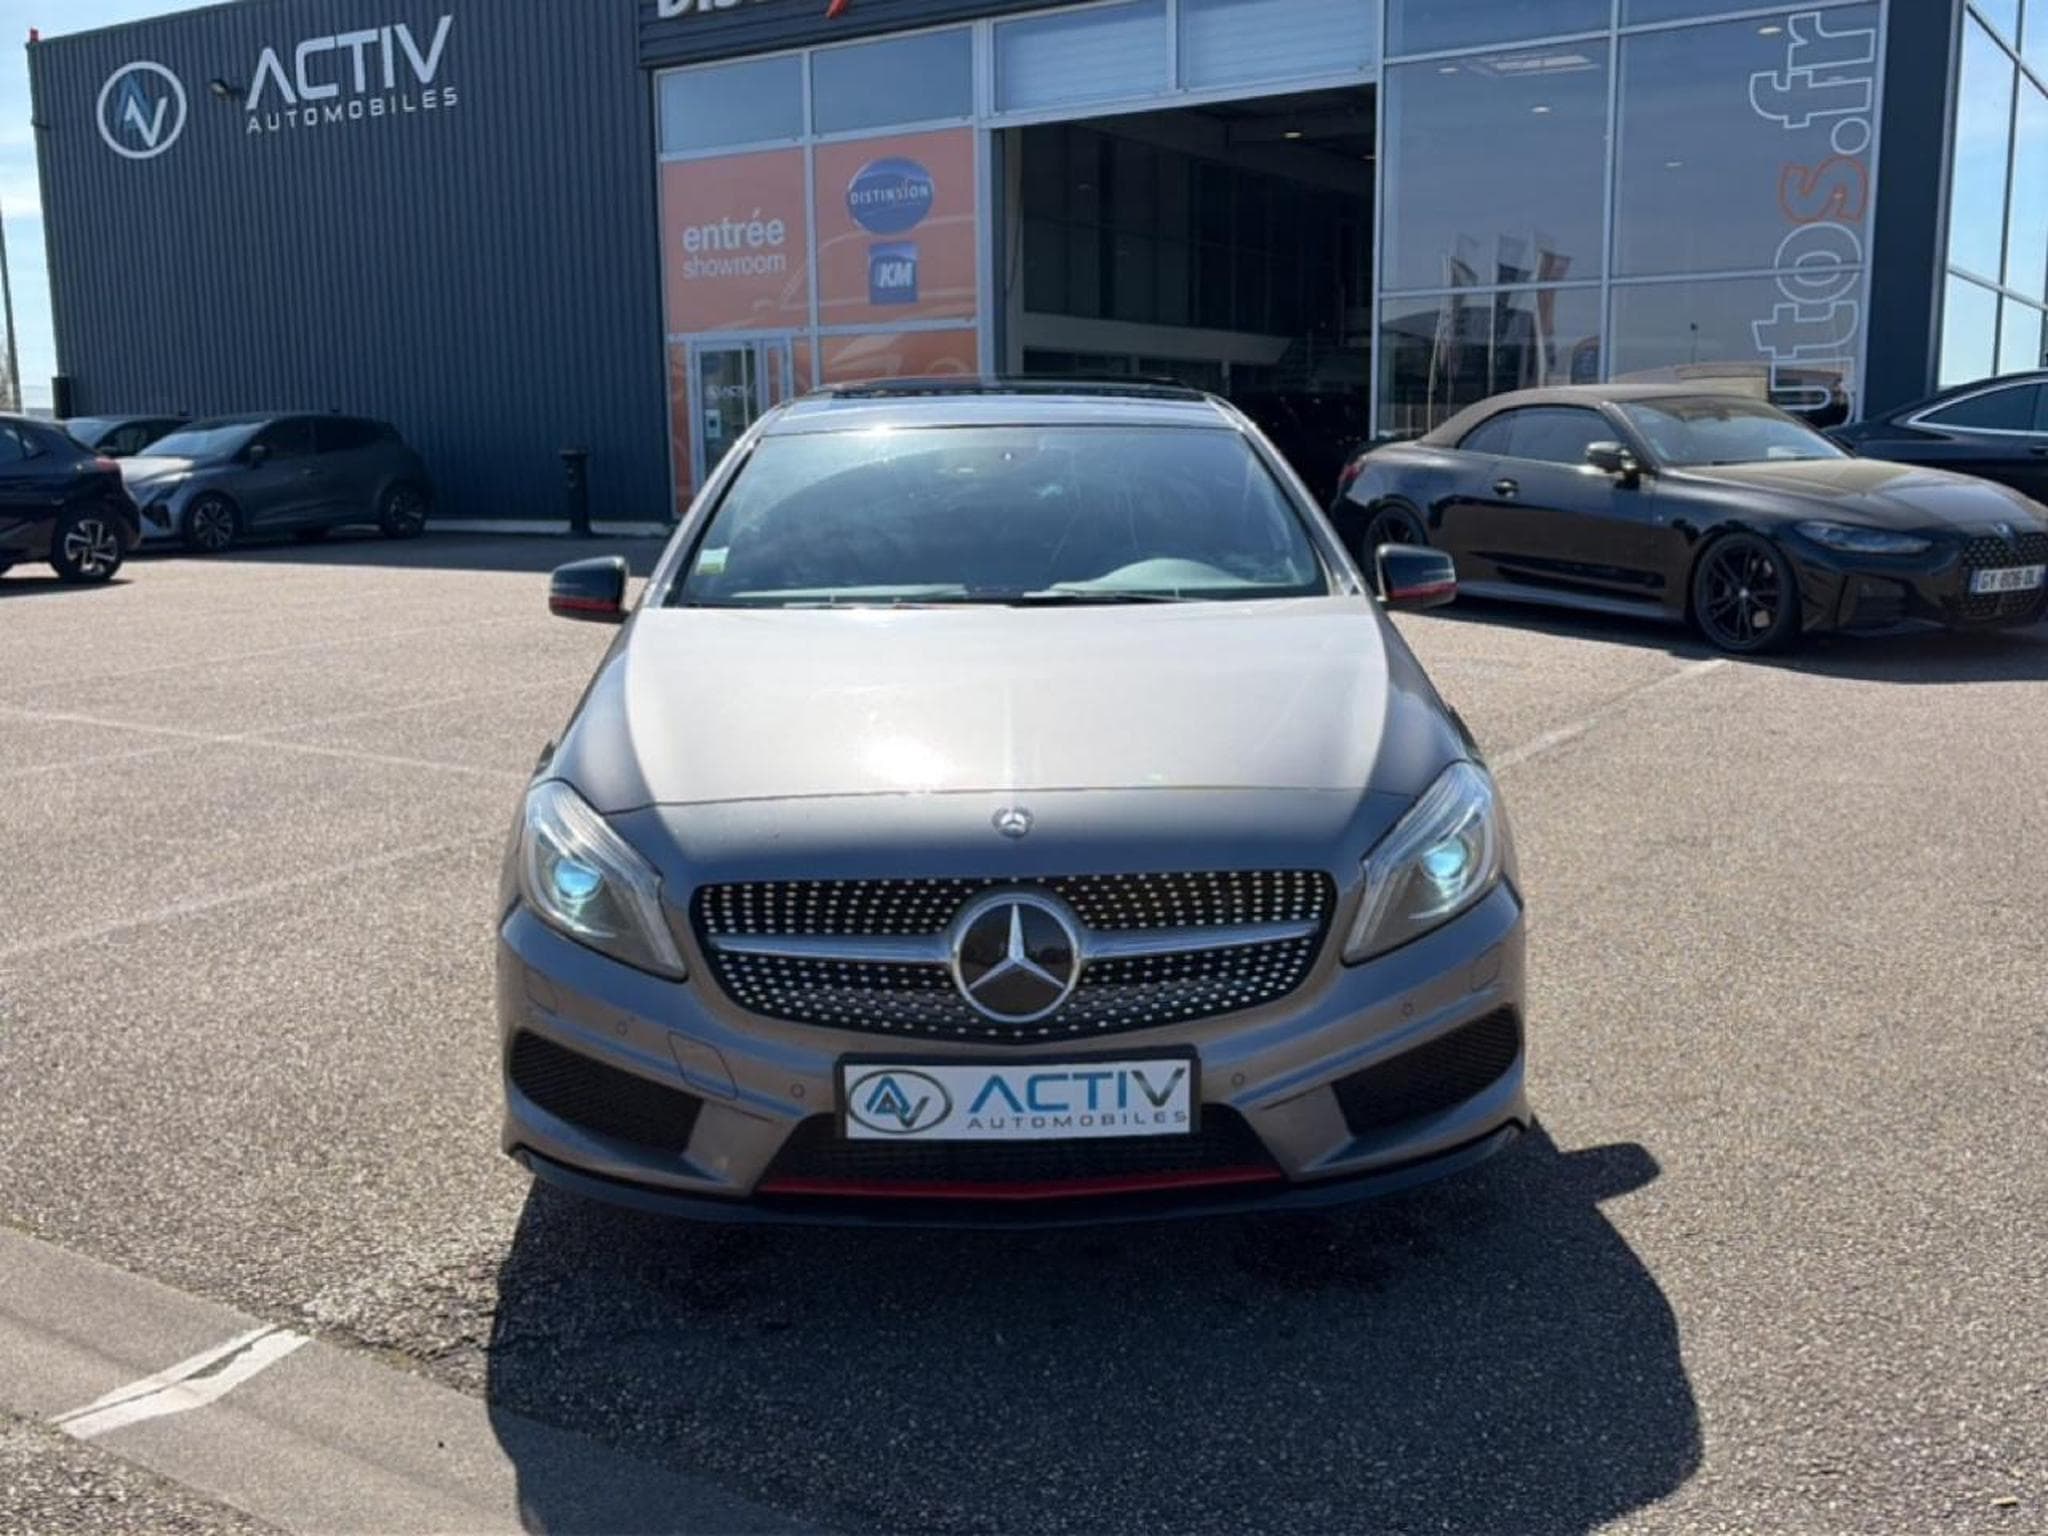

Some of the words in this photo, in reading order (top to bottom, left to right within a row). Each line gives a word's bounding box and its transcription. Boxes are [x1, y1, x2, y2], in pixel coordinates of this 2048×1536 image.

[245, 15, 453, 110] ACTIV
[246, 87, 459, 134] AUTOMOBILES
[682, 207, 785, 254] entrée
[683, 253, 786, 280] showroom
[878, 262, 914, 289] KM
[969, 1067, 1186, 1114] ACTIV
[967, 1111, 1189, 1130] AUTOMOBILES
